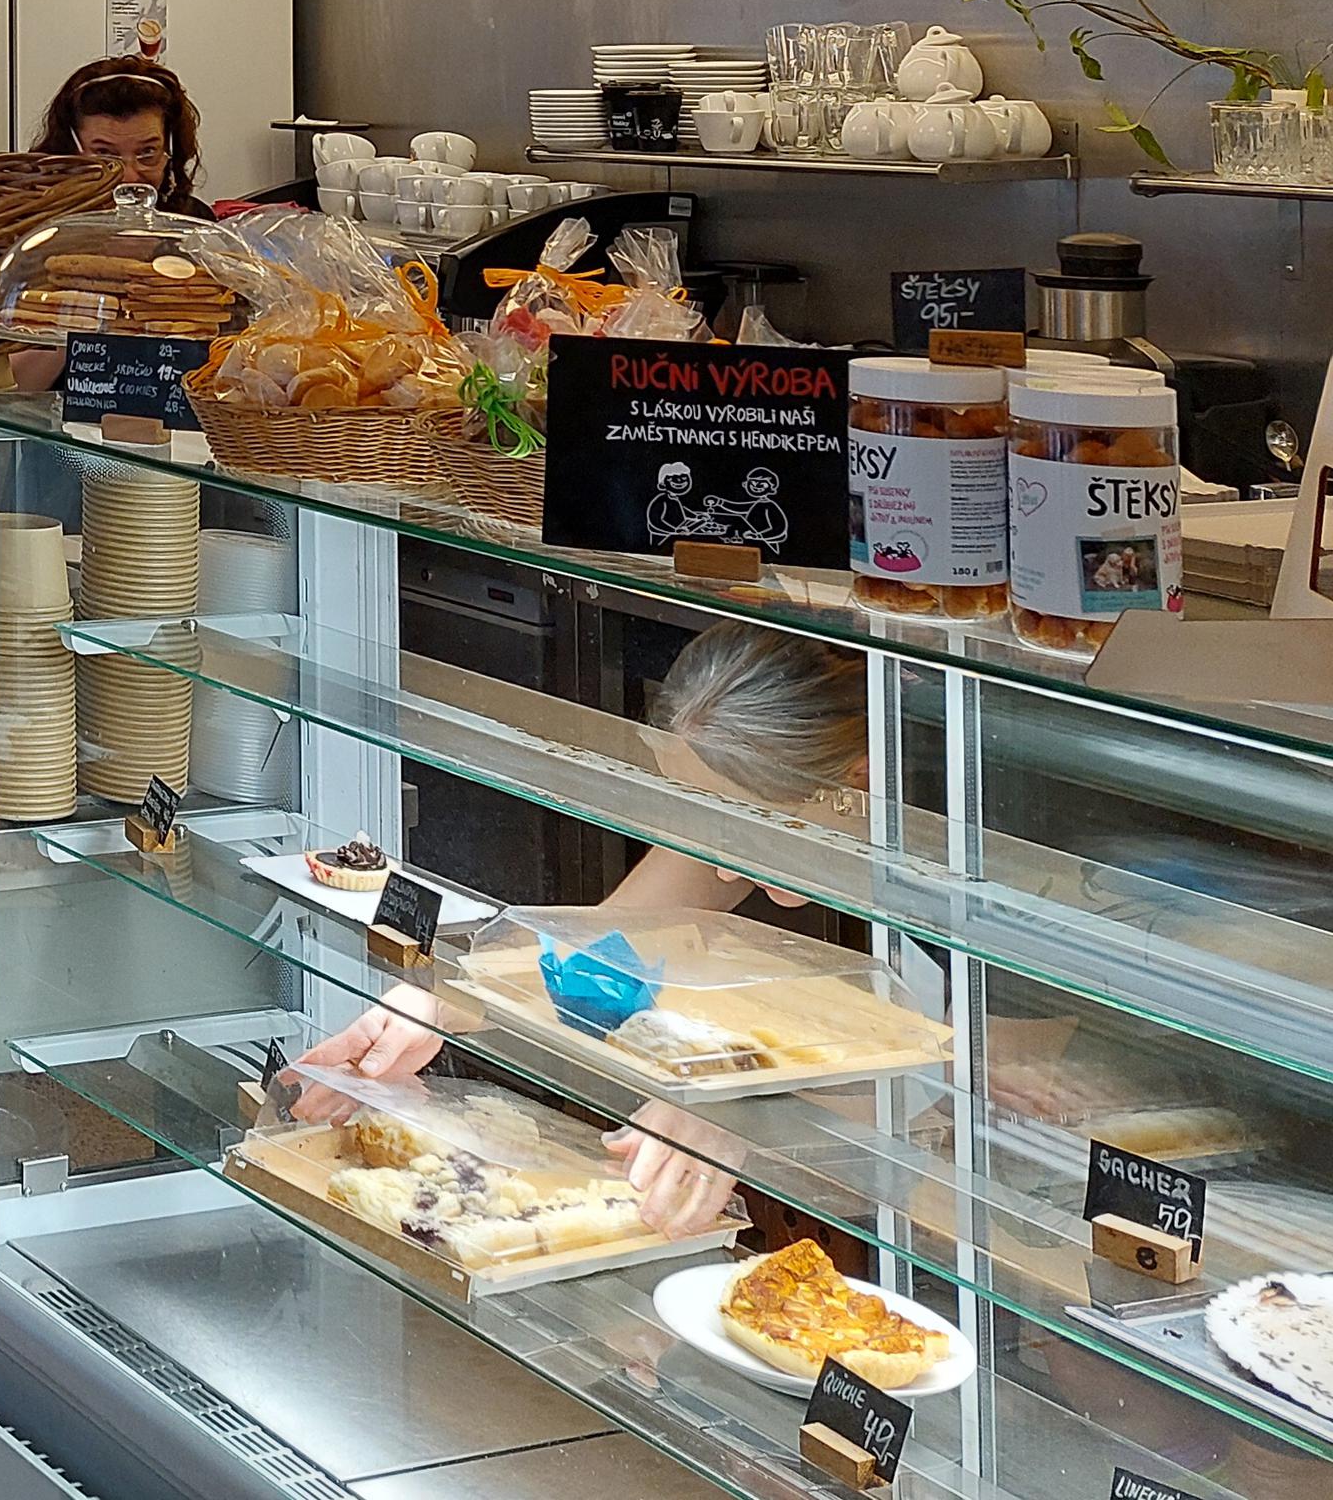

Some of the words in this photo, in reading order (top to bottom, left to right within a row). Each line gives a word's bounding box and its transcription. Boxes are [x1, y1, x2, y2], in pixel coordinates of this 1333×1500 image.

[72, 340, 107, 356] COOKIES
[611, 353, 699, 392] RUČNÍ
[707, 359, 836, 399] VÝROBA
[630, 401, 639, 415] S
[643, 399, 701, 420] LÁSKOU
[705, 405, 776, 424] VYROBILI
[606, 422, 724, 446] ZAMĚSTNANCI
[729, 431, 737, 446] S
[741, 431, 841, 454] HENDIKEPEM
[1087, 477, 1177, 519] ŠTĚKSY
[1098, 1149, 1192, 1206] SACHER
[823, 1371, 866, 1409] QUICHE
